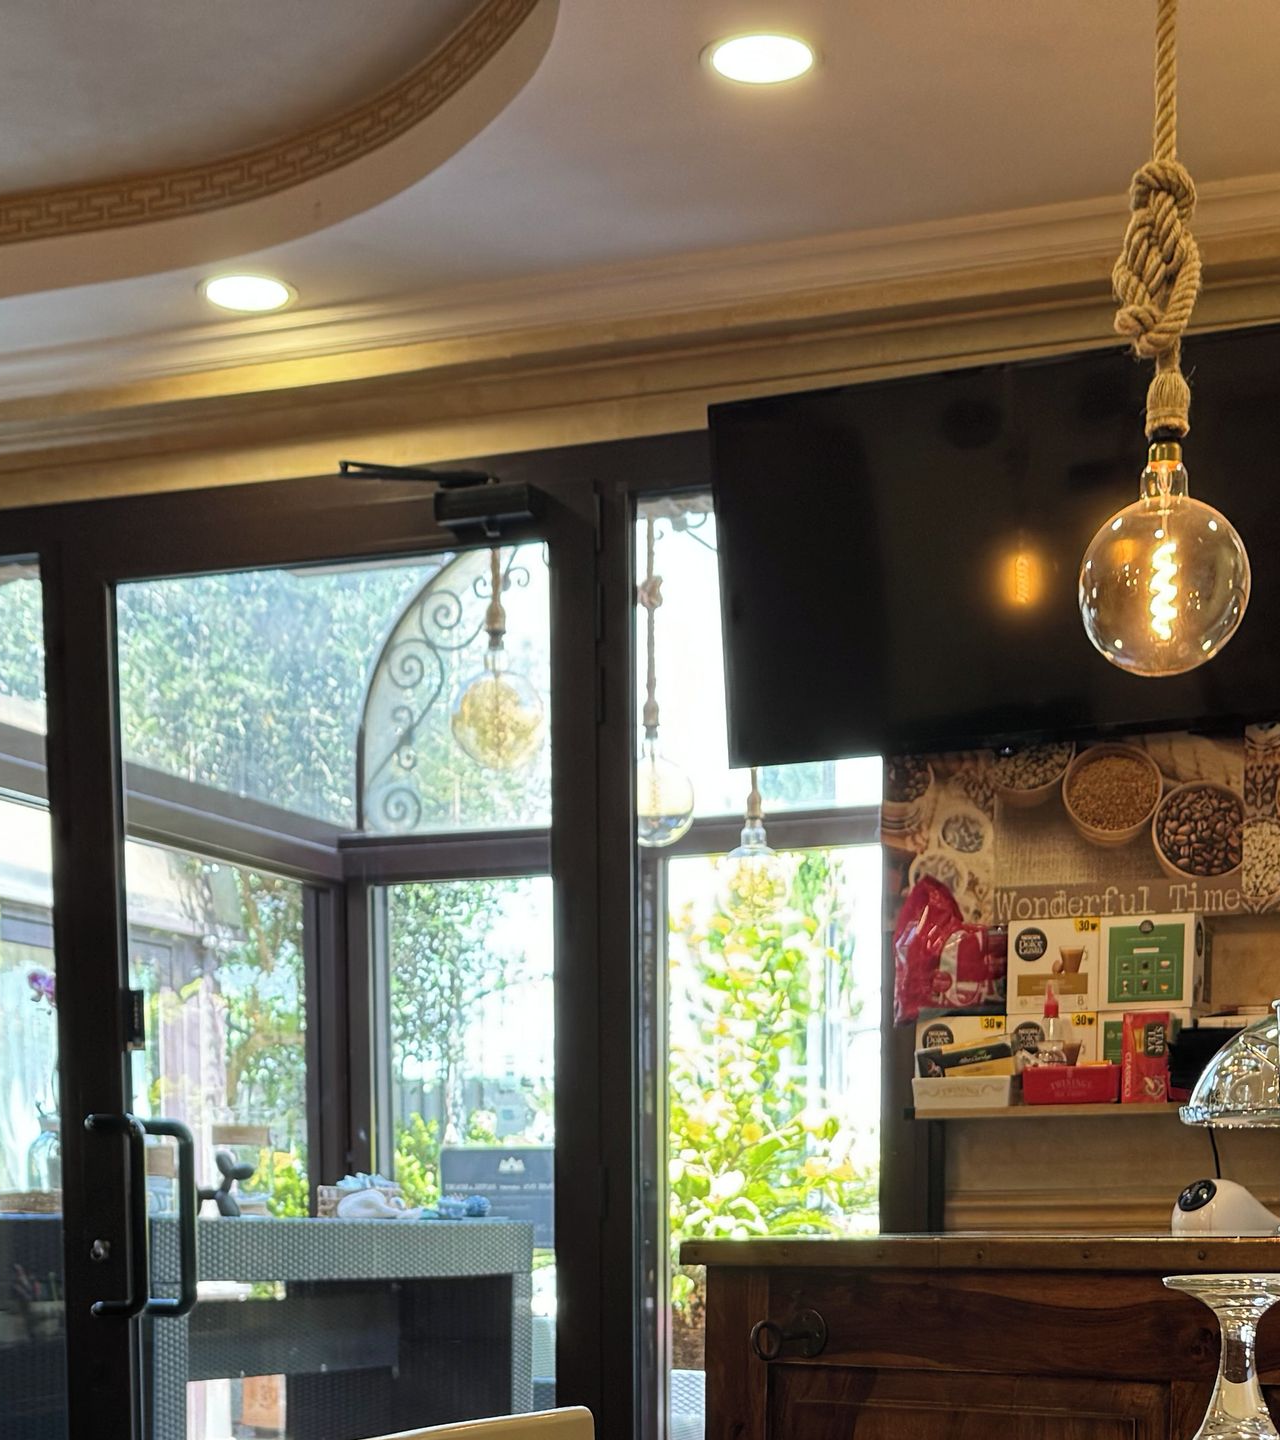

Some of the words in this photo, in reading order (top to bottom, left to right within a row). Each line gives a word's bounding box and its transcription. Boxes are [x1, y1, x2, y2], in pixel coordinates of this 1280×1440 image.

[995, 885, 1157, 921] Wonderful
[1169, 882, 1243, 914] Time
[1079, 919, 1090, 932] 30
[984, 1018, 995, 1029] 30
[1075, 1015, 1087, 1026] 30
[1147, 1031, 1156, 1052] TEA
[1155, 1025, 1164, 1053] STAR
[1124, 1052, 1132, 1097] CLASSICO
